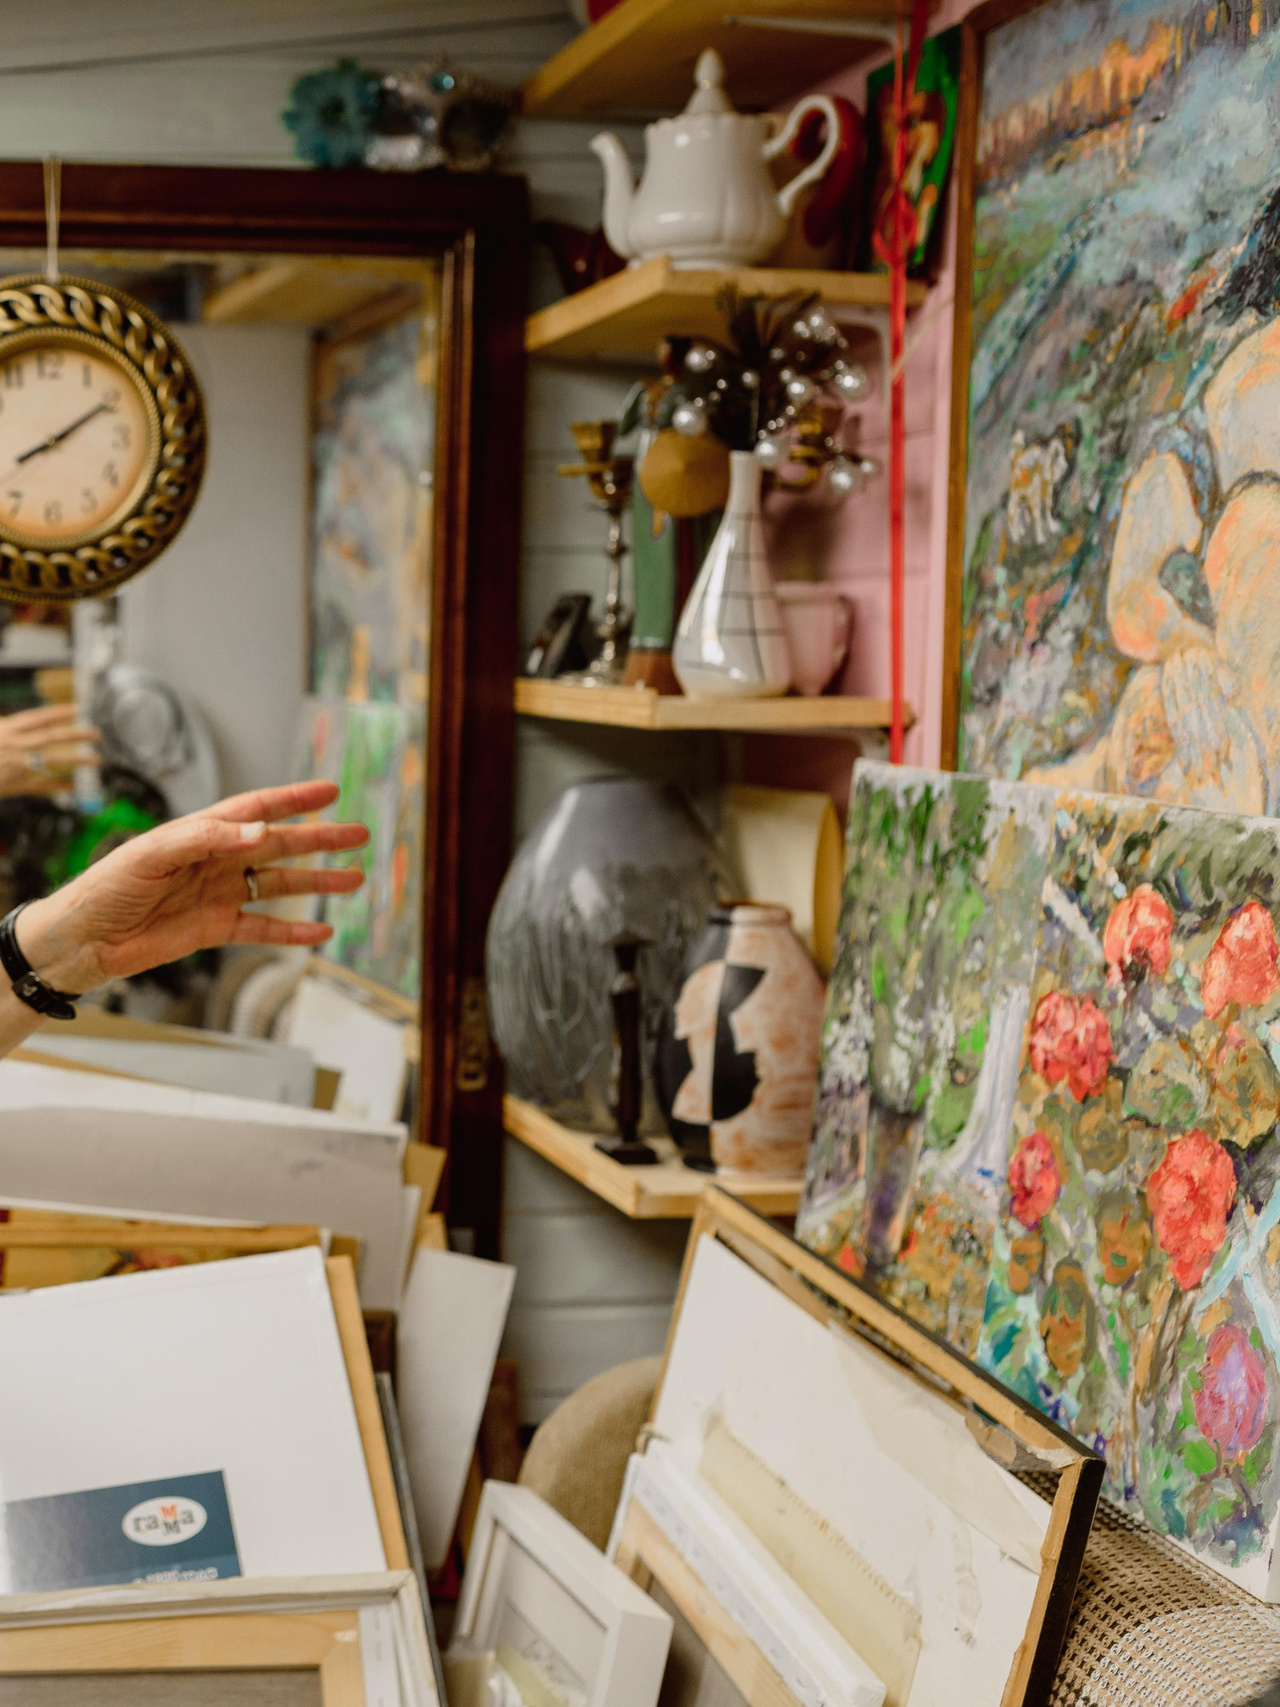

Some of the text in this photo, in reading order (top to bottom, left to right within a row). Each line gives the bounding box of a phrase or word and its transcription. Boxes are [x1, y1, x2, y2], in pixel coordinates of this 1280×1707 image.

[4, 359, 24, 389] 11
[36, 351, 65, 380] 12
[82, 364, 92, 388] 1
[111, 424, 131, 450] 3
[101, 460, 119, 489] 4
[6, 489, 24, 516] 7
[42, 499, 64, 528] 6
